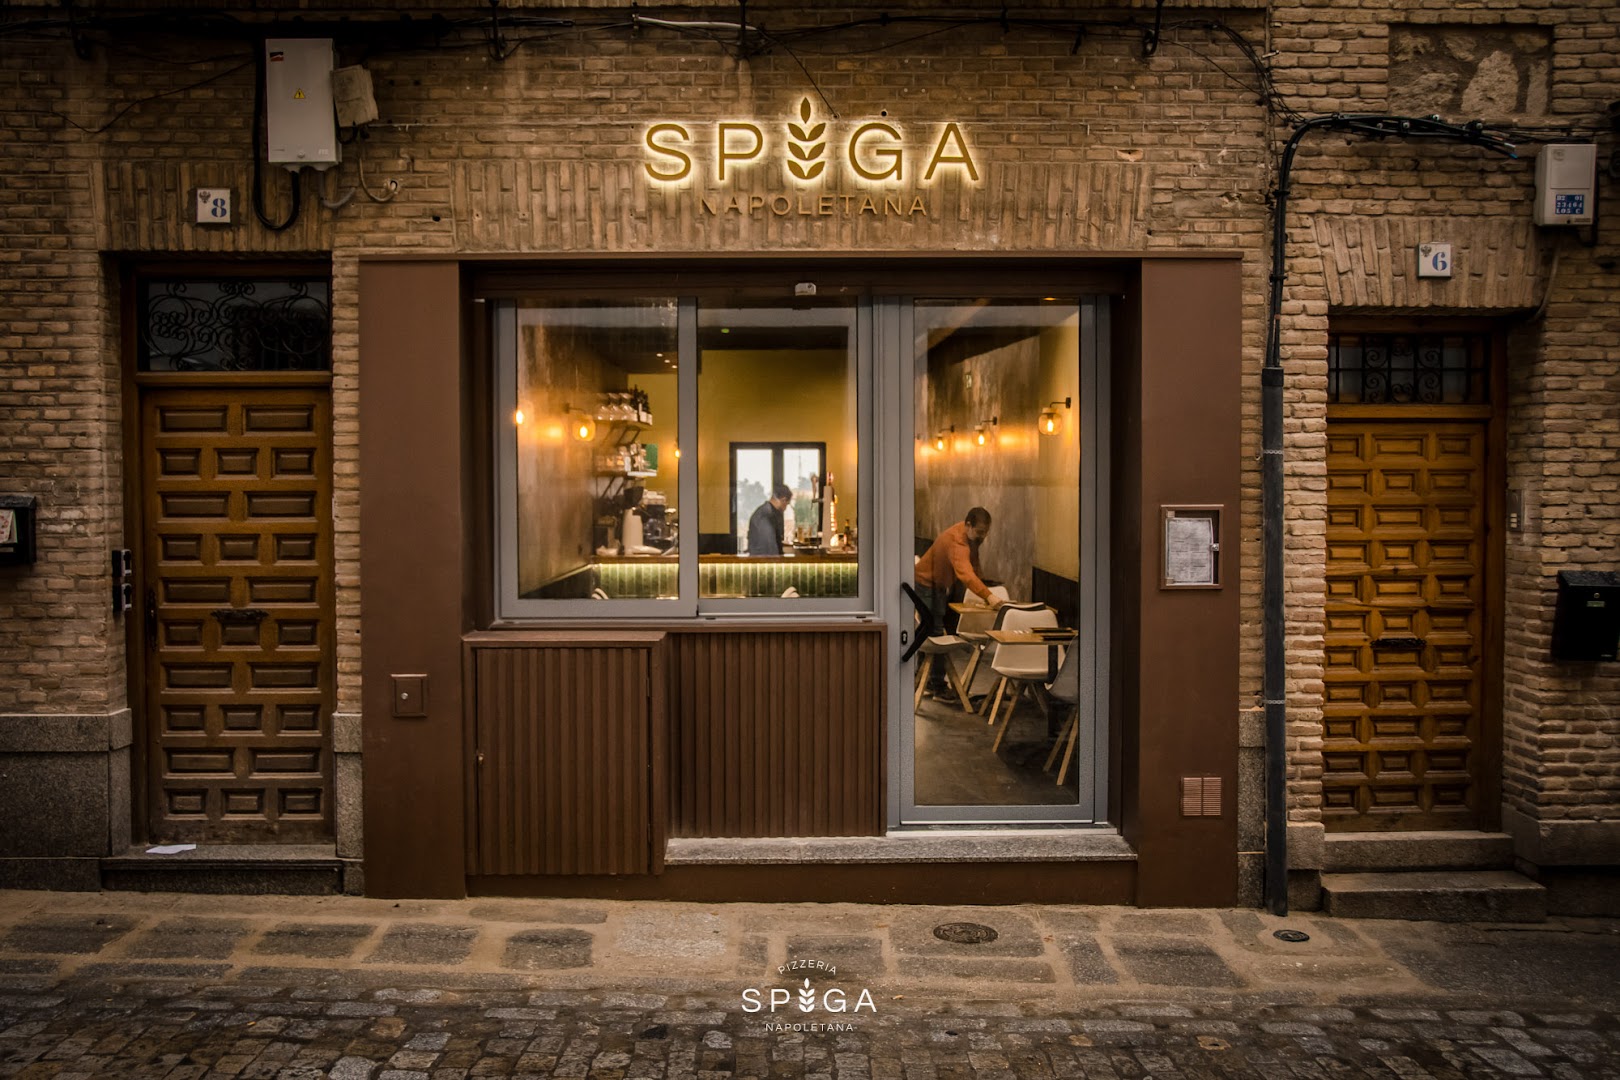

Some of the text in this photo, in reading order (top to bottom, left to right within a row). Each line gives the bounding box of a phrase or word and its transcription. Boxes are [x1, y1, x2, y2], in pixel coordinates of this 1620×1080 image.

[211, 198, 227, 218] 8
[698, 196, 927, 217] NAPOLETANA
[1432, 252, 1447, 272] 6
